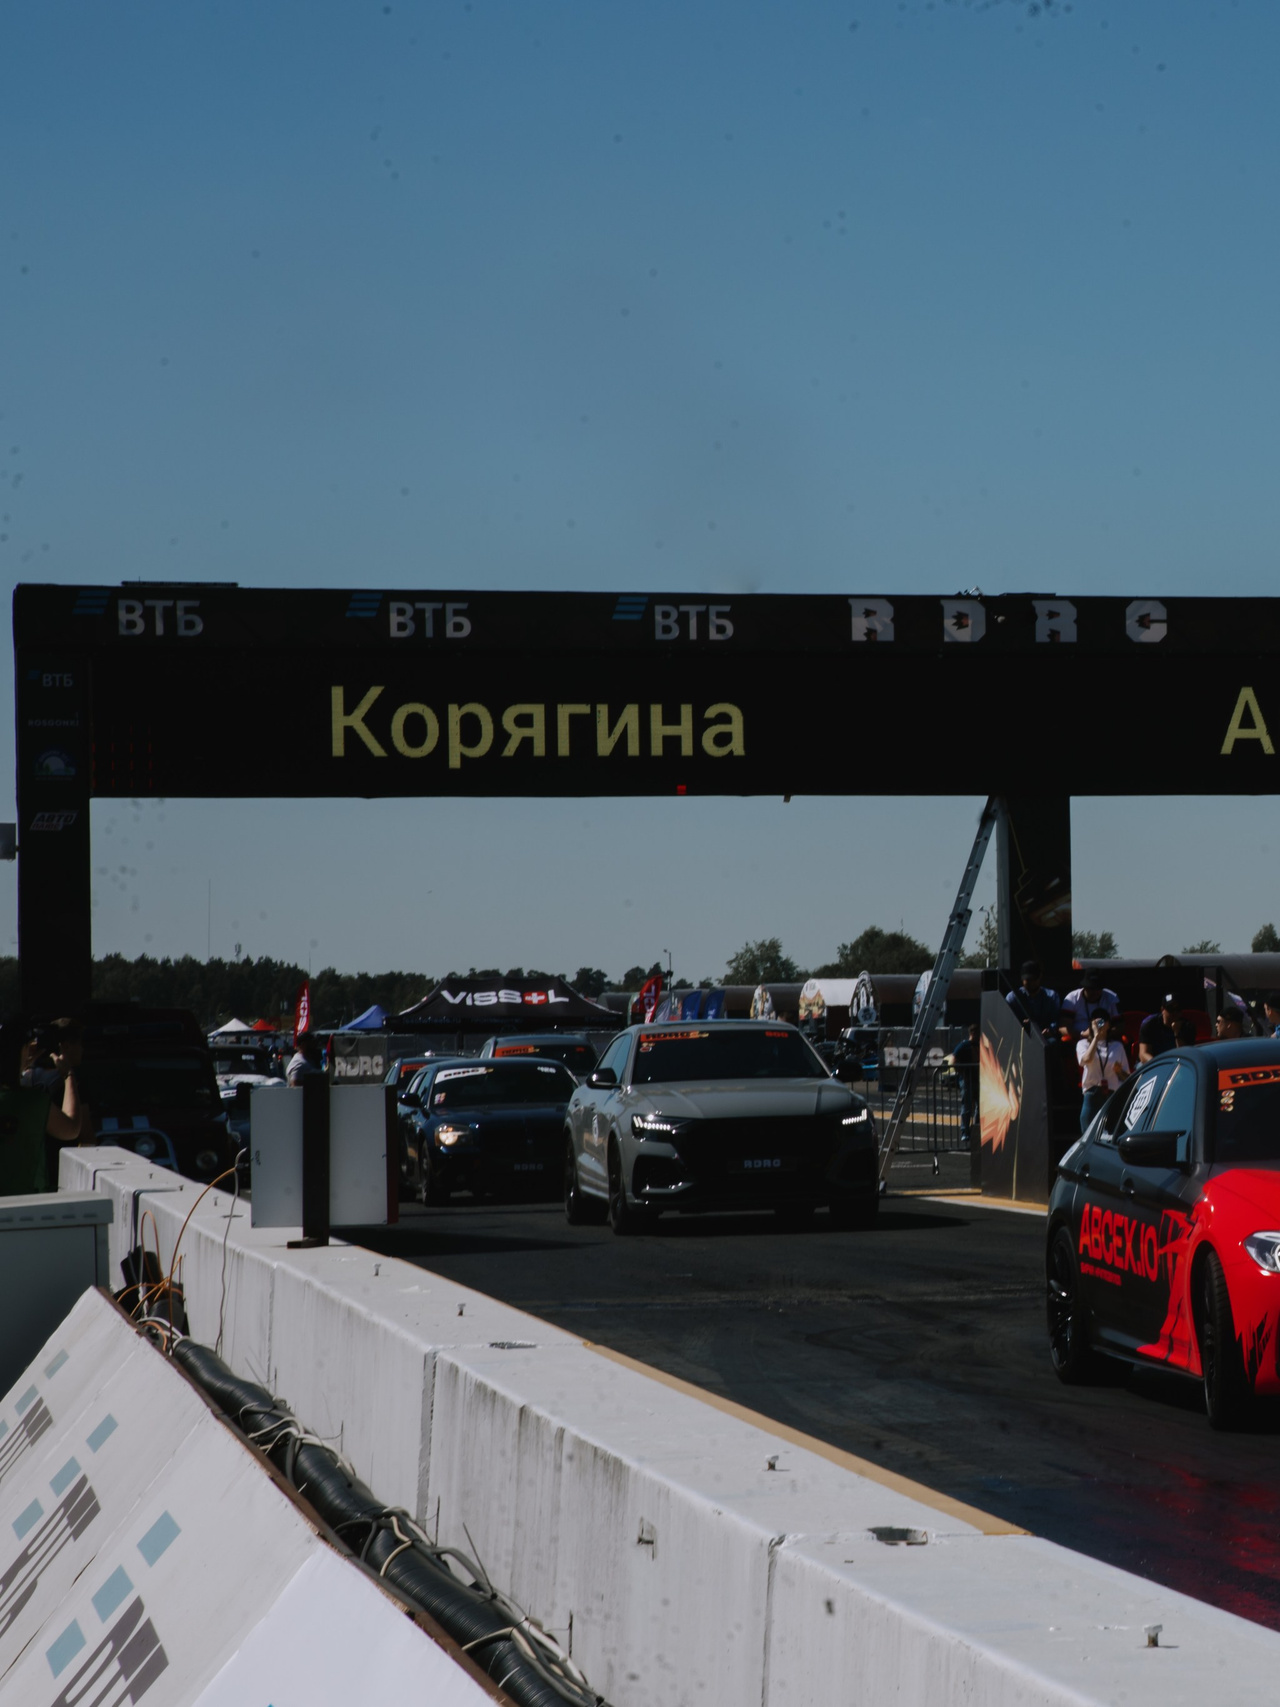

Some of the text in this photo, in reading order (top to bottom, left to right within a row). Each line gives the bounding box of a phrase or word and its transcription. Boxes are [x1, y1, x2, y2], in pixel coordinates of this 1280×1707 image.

[118, 599, 204, 637] ВТБ
[388, 603, 472, 639] ВТБ
[654, 604, 734, 641] ВТБ
[849, 598, 1168, 643] RDRC
[42, 672, 74, 688] ВТБ
[331, 685, 746, 769] Корягина
[334, 1055, 384, 1077] RDRC
